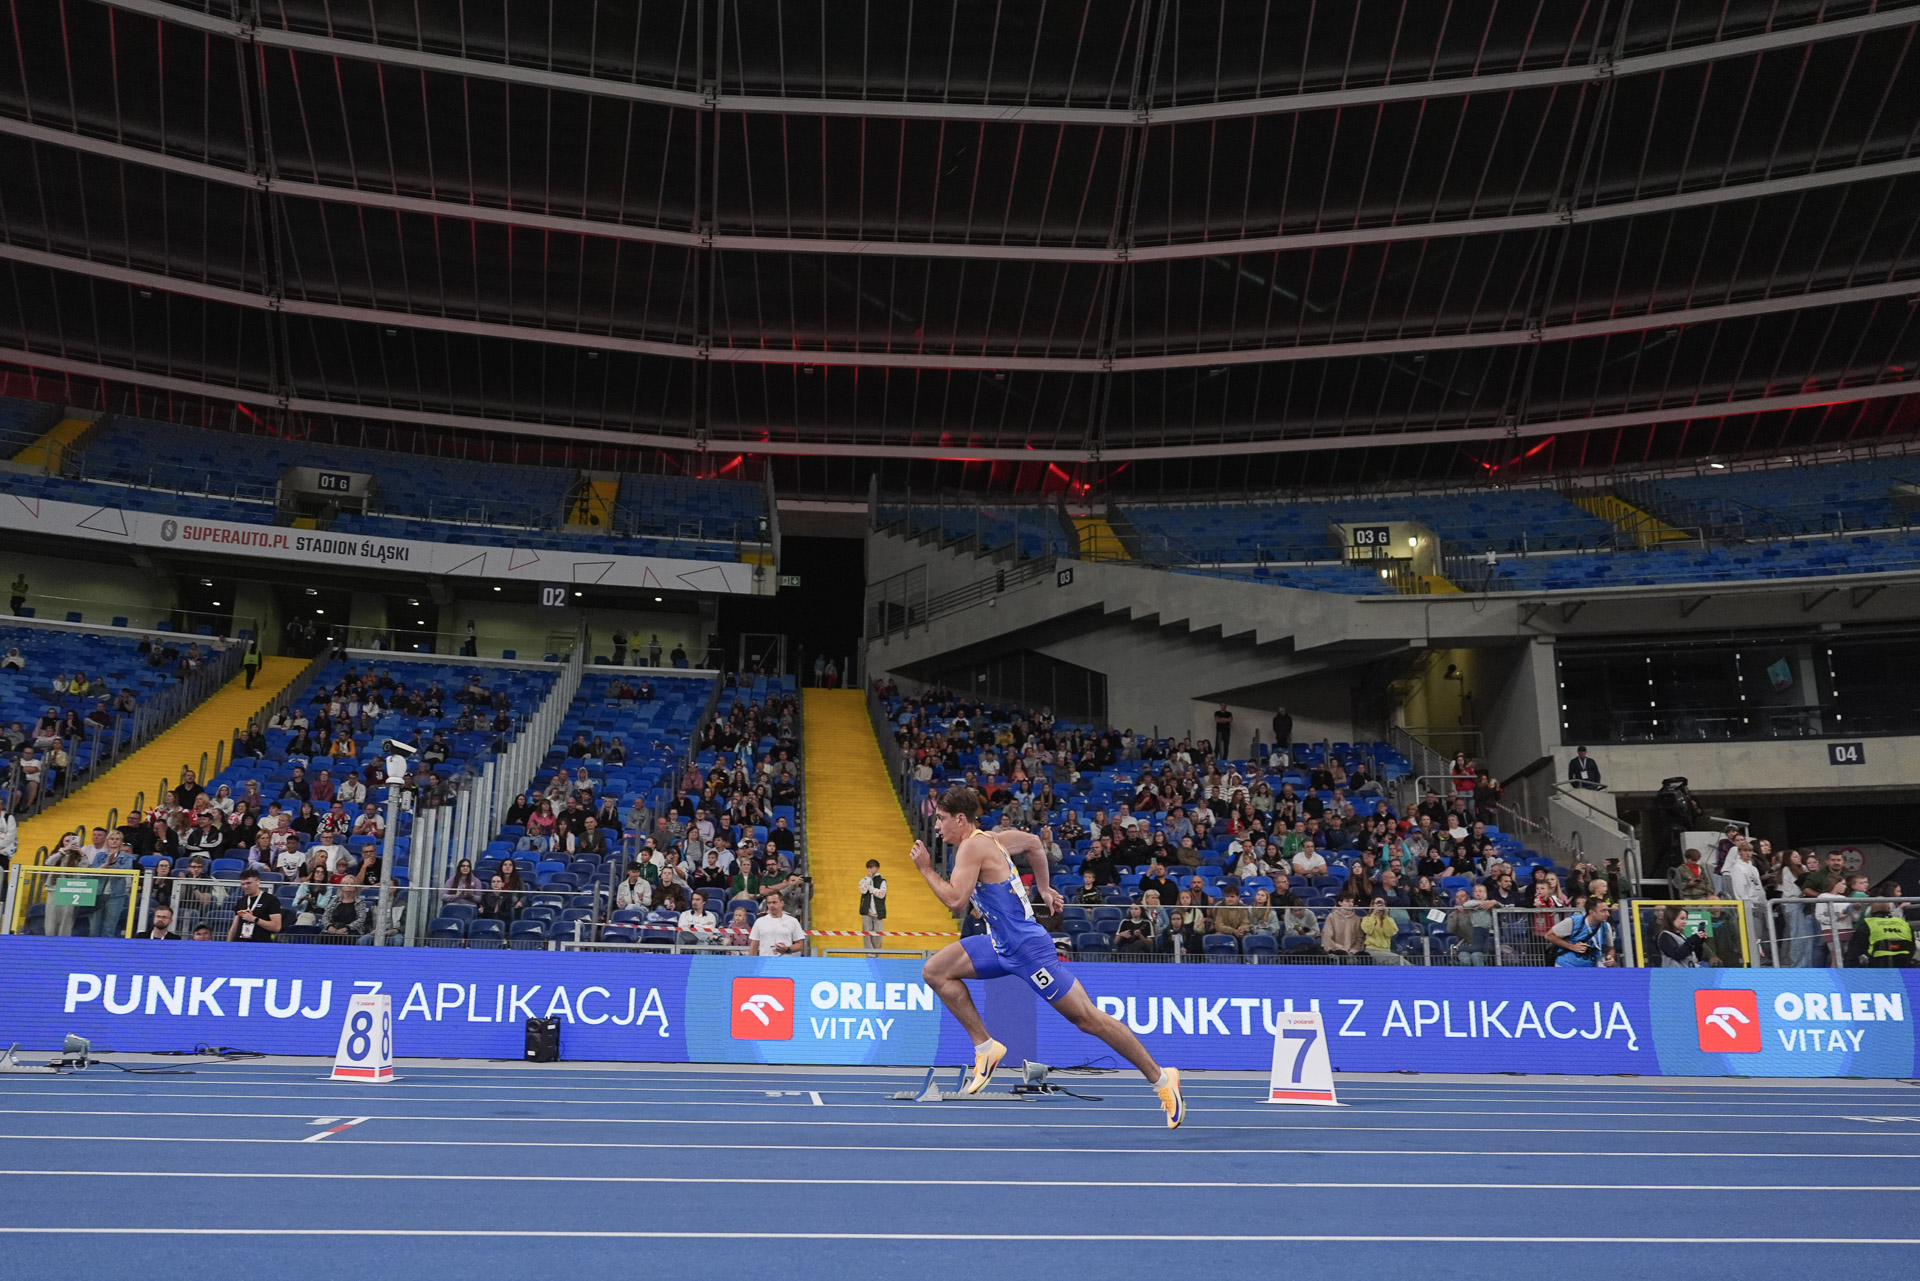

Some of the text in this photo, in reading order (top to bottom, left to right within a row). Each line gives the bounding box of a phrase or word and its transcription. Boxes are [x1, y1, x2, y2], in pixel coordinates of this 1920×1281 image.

[320, 475, 348, 490] 01 G
[183, 525, 410, 563] SUPERAUTO.PL STADION ŚLĄSKI
[1356, 530, 1388, 544] 03 G
[1060, 570, 1070, 584] 03
[542, 587, 565, 607] 02
[1835, 746, 1858, 761] 04
[72, 894, 80, 905] 2
[1035, 971, 1050, 986] 5
[64, 973, 669, 1038] PUNKTUJ APLIKACJĄ
[810, 981, 934, 1011] ORLEN
[1774, 992, 1904, 1021] ORLEN
[347, 1010, 373, 1061] 8
[382, 1011, 389, 1061] 8
[810, 1017, 895, 1040] VITAY
[1338, 999, 1367, 1037] Z
[1382, 999, 1639, 1051] APLIKACJĄ
[1777, 1029, 1865, 1052] VITAY
[1282, 1029, 1318, 1083] 7
